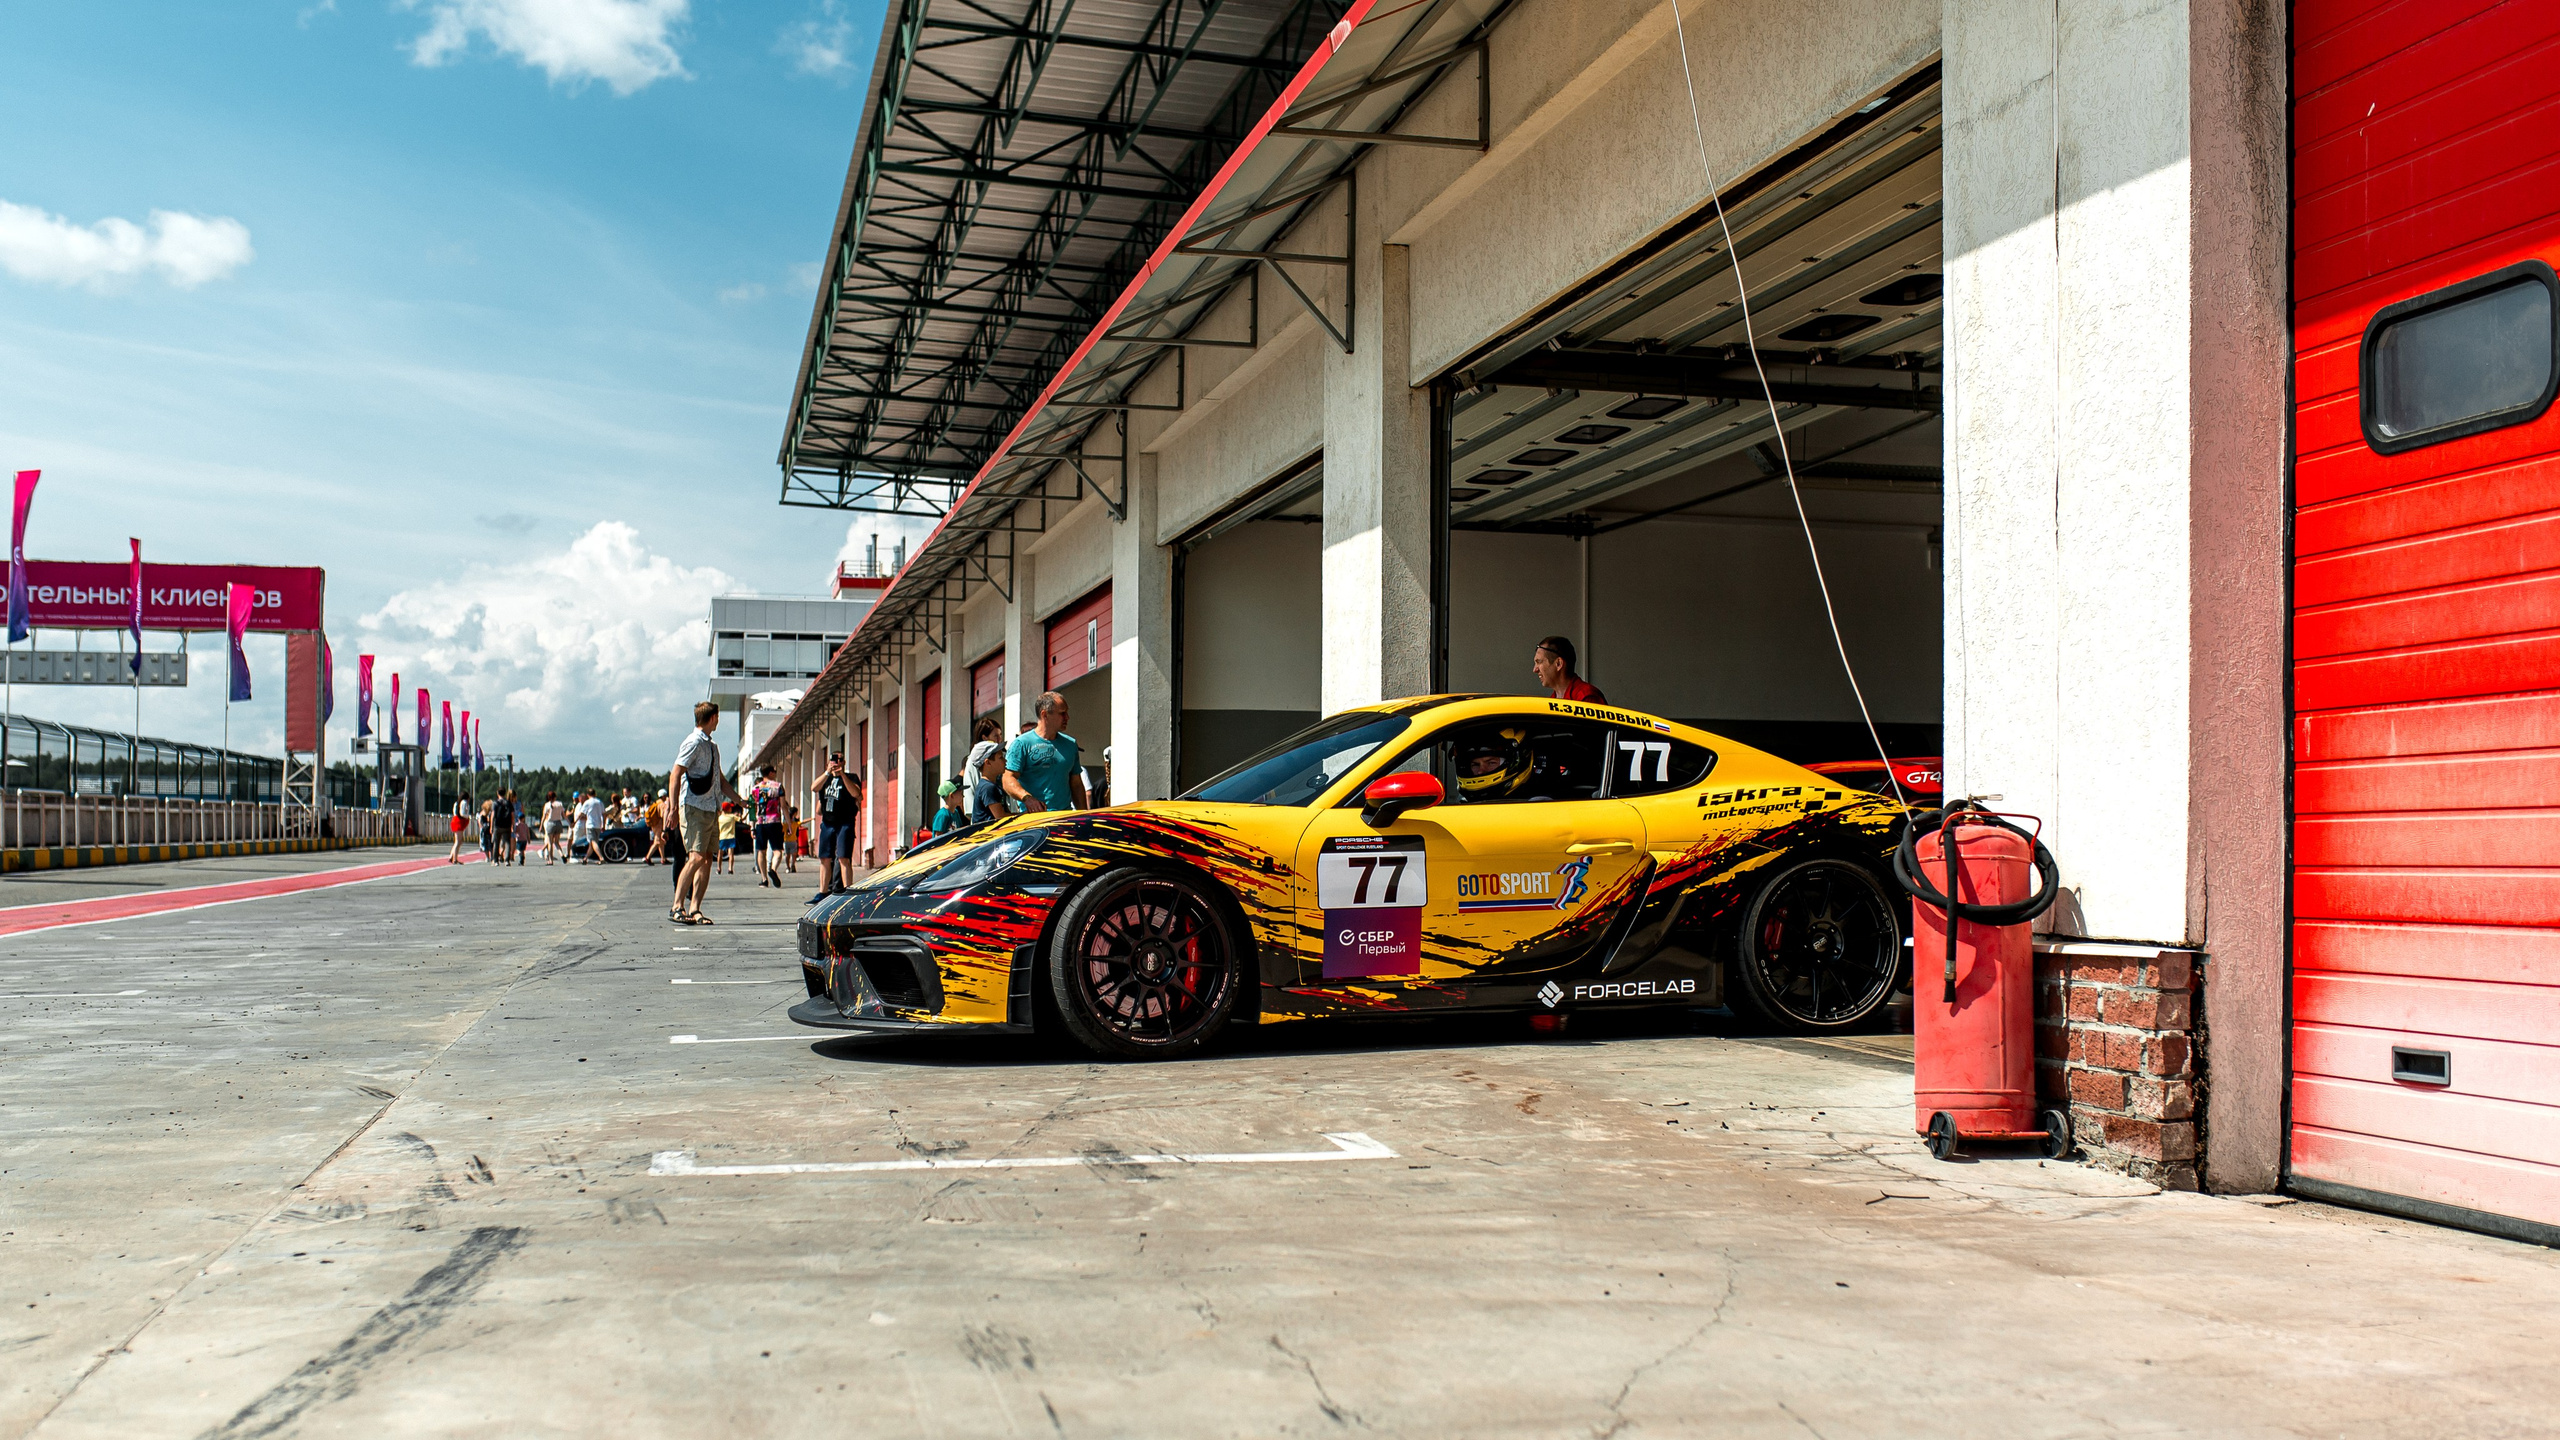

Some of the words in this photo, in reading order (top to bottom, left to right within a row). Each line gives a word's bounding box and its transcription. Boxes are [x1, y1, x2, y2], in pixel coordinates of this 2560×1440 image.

[151, 587, 283, 608] клиенов
[1618, 741, 1672, 782] 77
[1906, 771, 1942, 784] GT4
[1348, 856, 1408, 905] 77
[1457, 872, 1551, 896] GOTOSPORT
[1358, 931, 1394, 942] СБЕР
[1358, 941, 1406, 956] Первый
[1574, 979, 1696, 1000] FORCELAB
